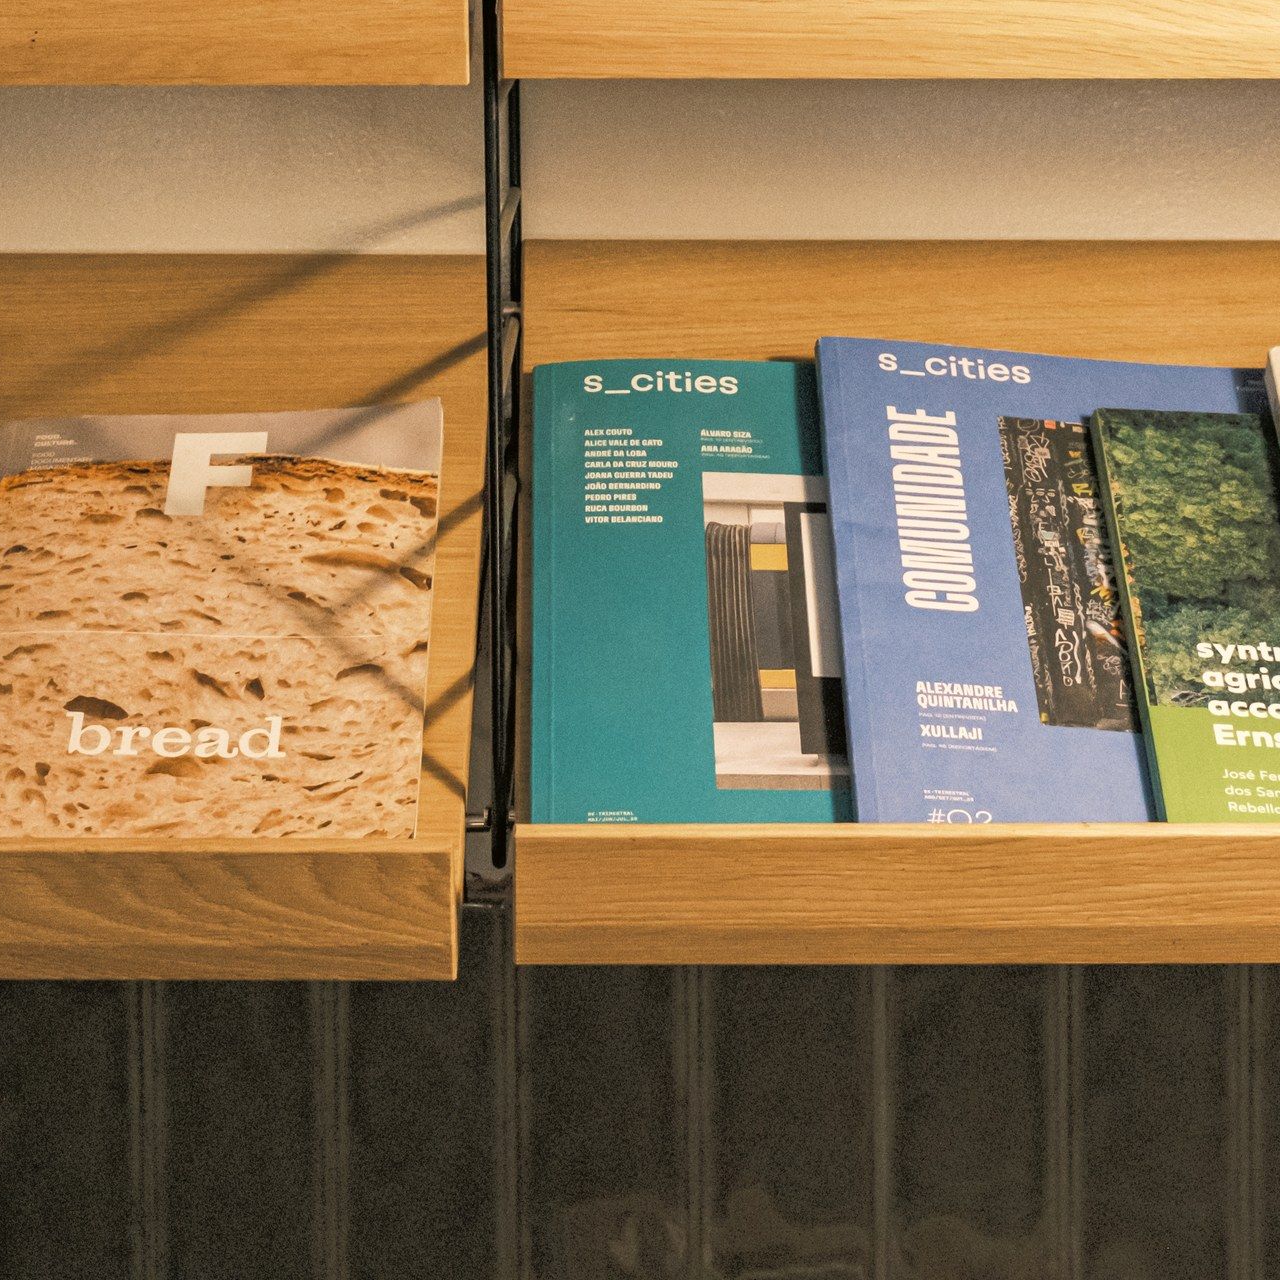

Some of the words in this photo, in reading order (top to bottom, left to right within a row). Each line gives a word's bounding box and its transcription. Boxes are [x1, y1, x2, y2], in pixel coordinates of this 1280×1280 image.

[878, 352, 1032, 384] s_cities
[583, 372, 739, 395] s_cities
[584, 428, 605, 436] ALEX
[605, 428, 633, 436] COUTO
[733, 431, 752, 439] SIZA
[584, 439, 607, 447] ALICE
[608, 439, 628, 447] VALE
[629, 439, 640, 447] DE
[642, 439, 663, 447] GATO
[701, 444, 719, 453] ANA
[163, 431, 269, 516] F
[608, 482, 662, 490] BERNARDINO
[585, 493, 612, 501] PEDRO
[613, 493, 637, 501] PIRES
[585, 504, 607, 512] RUCA
[608, 504, 648, 512] BOURBON
[886, 405, 980, 612] COMUNIDADE
[915, 681, 1004, 699] ALEXANDRE
[917, 694, 1019, 714] QUINTANILHA
[65, 710, 287, 759] bread
[920, 723, 983, 741] XULLAJI
[1222, 768, 1256, 781] José
[1224, 784, 1252, 797] dos
